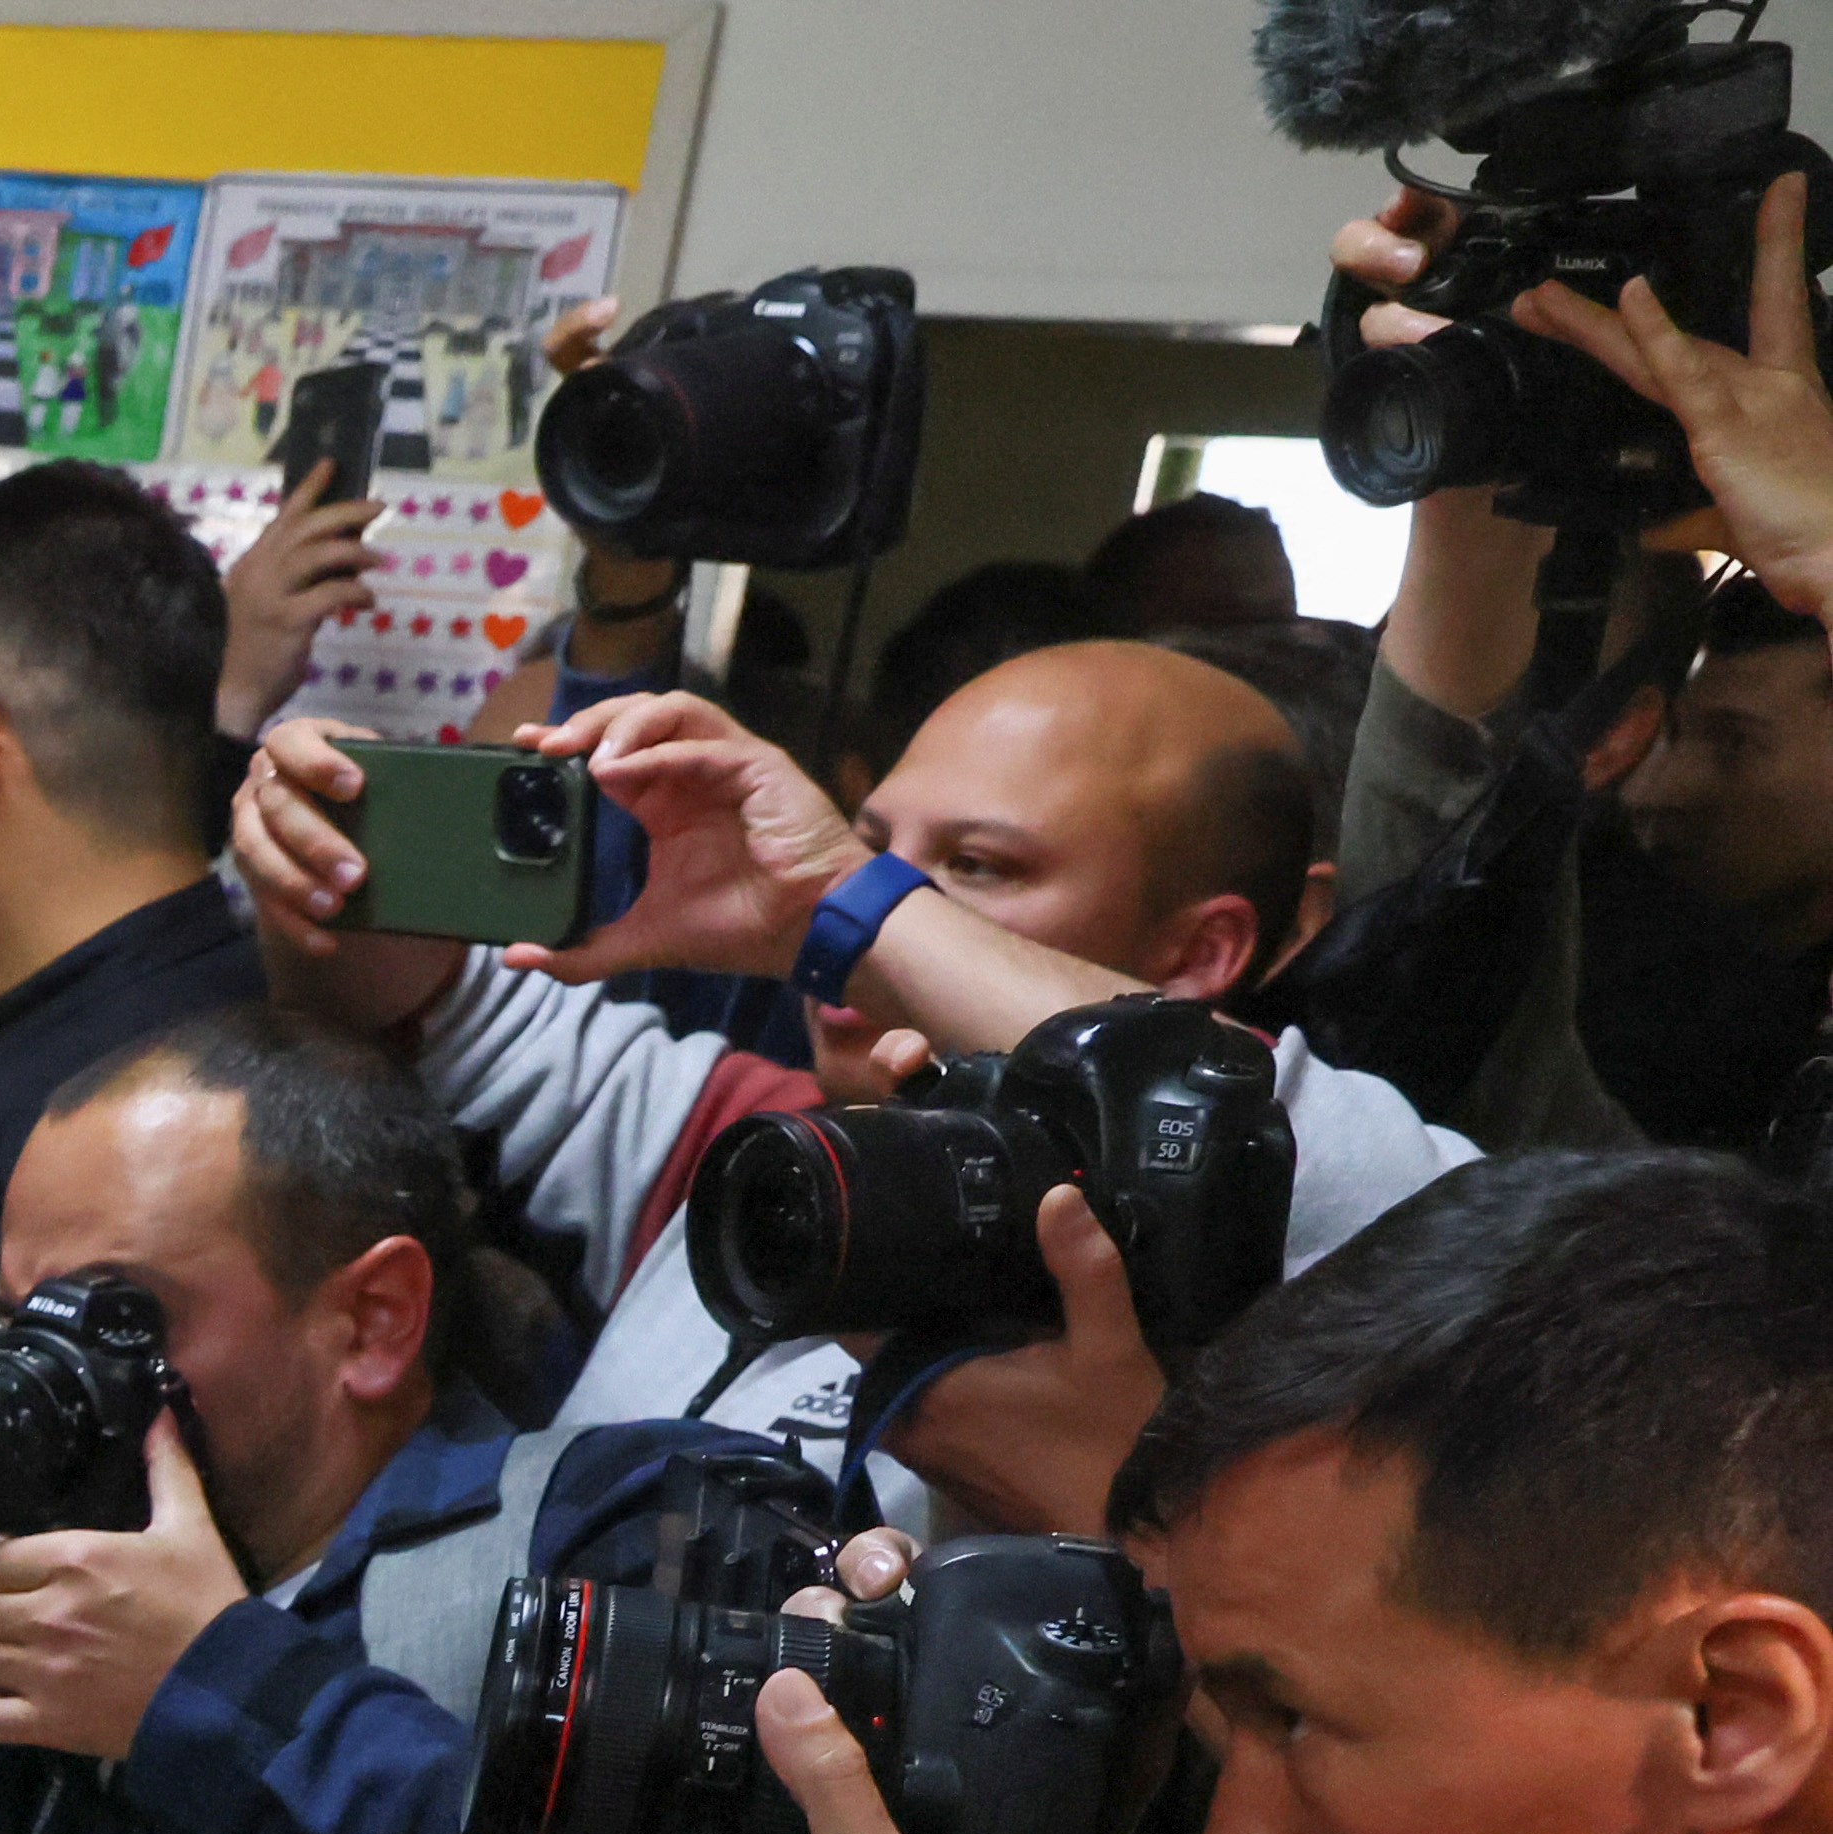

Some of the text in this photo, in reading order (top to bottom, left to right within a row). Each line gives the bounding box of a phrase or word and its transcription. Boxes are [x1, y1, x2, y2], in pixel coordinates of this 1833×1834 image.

[1555, 254, 1607, 271] LUMIX
[1158, 1118, 1195, 1137] EOS
[1157, 1141, 1181, 1159] 5D
[26, 1295, 77, 1319] Nikon
[568, 1591, 581, 1608] LENS
[564, 1610, 578, 1641] ZOOM
[504, 1638, 517, 1663] HOYA
[556, 1646, 573, 1689] CANON
[700, 1721, 749, 1735] STABILIZER
